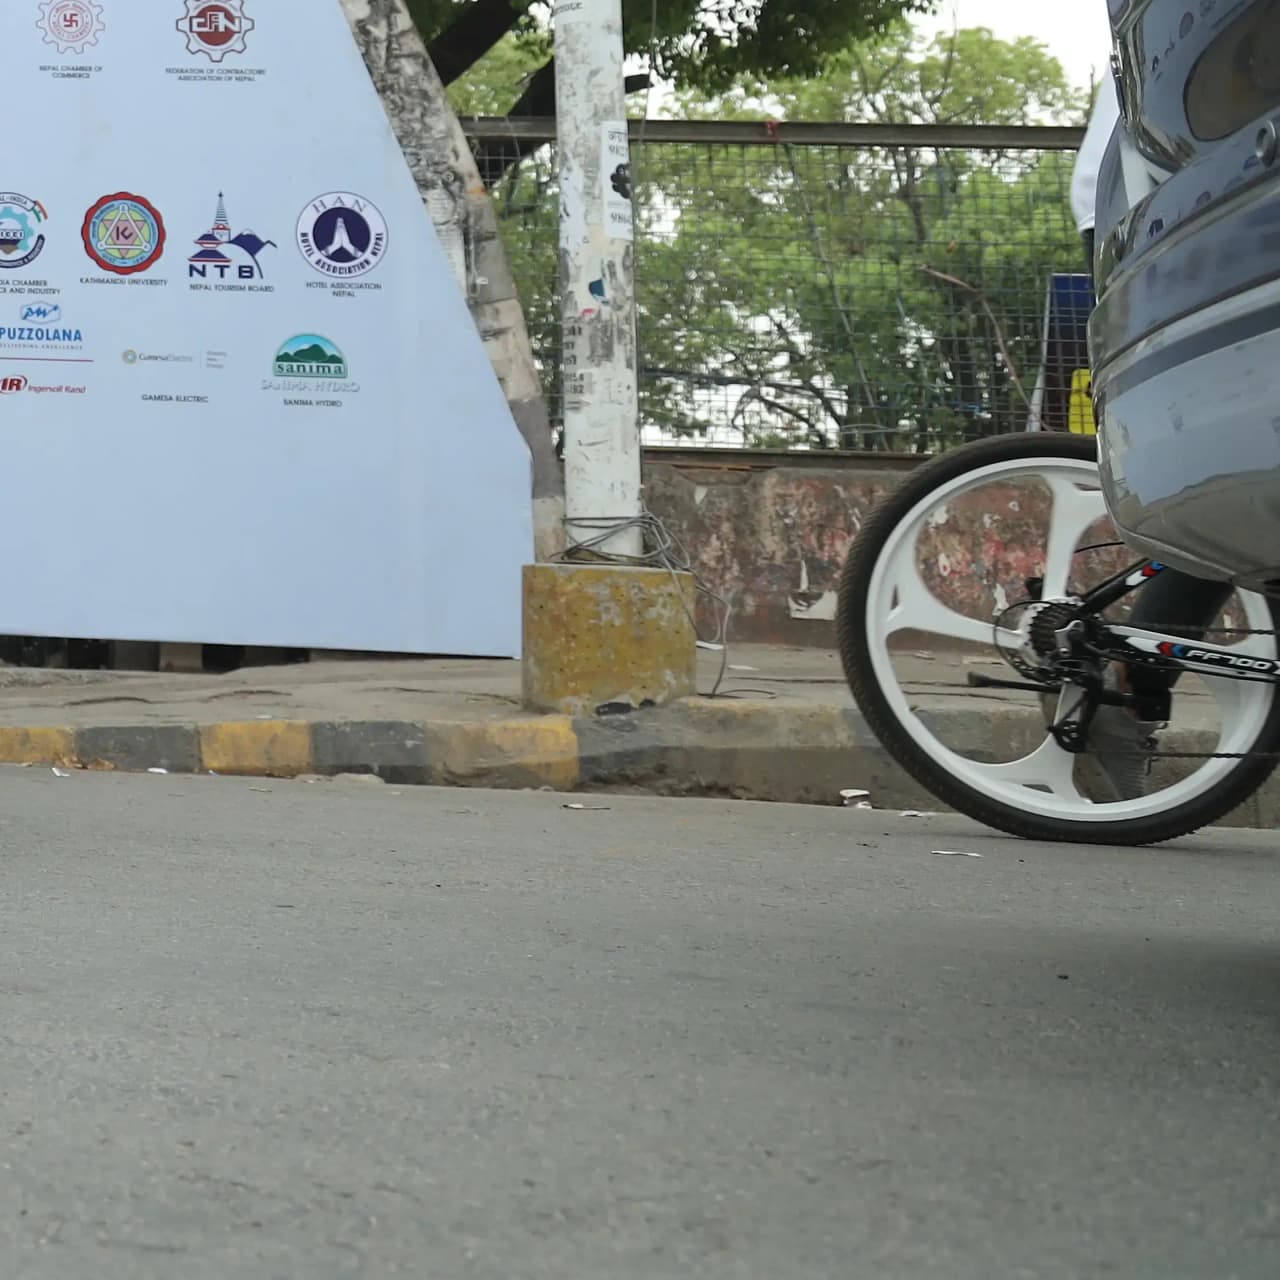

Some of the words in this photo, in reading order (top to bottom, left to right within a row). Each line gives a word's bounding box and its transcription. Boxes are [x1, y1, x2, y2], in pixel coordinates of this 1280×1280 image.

[188, 264, 255, 279] NTB
[276, 363, 344, 375] sanima
[0, 377, 22, 392] IR
[28, 385, 63, 395] Ingersoll
[65, 385, 86, 394] Rand
